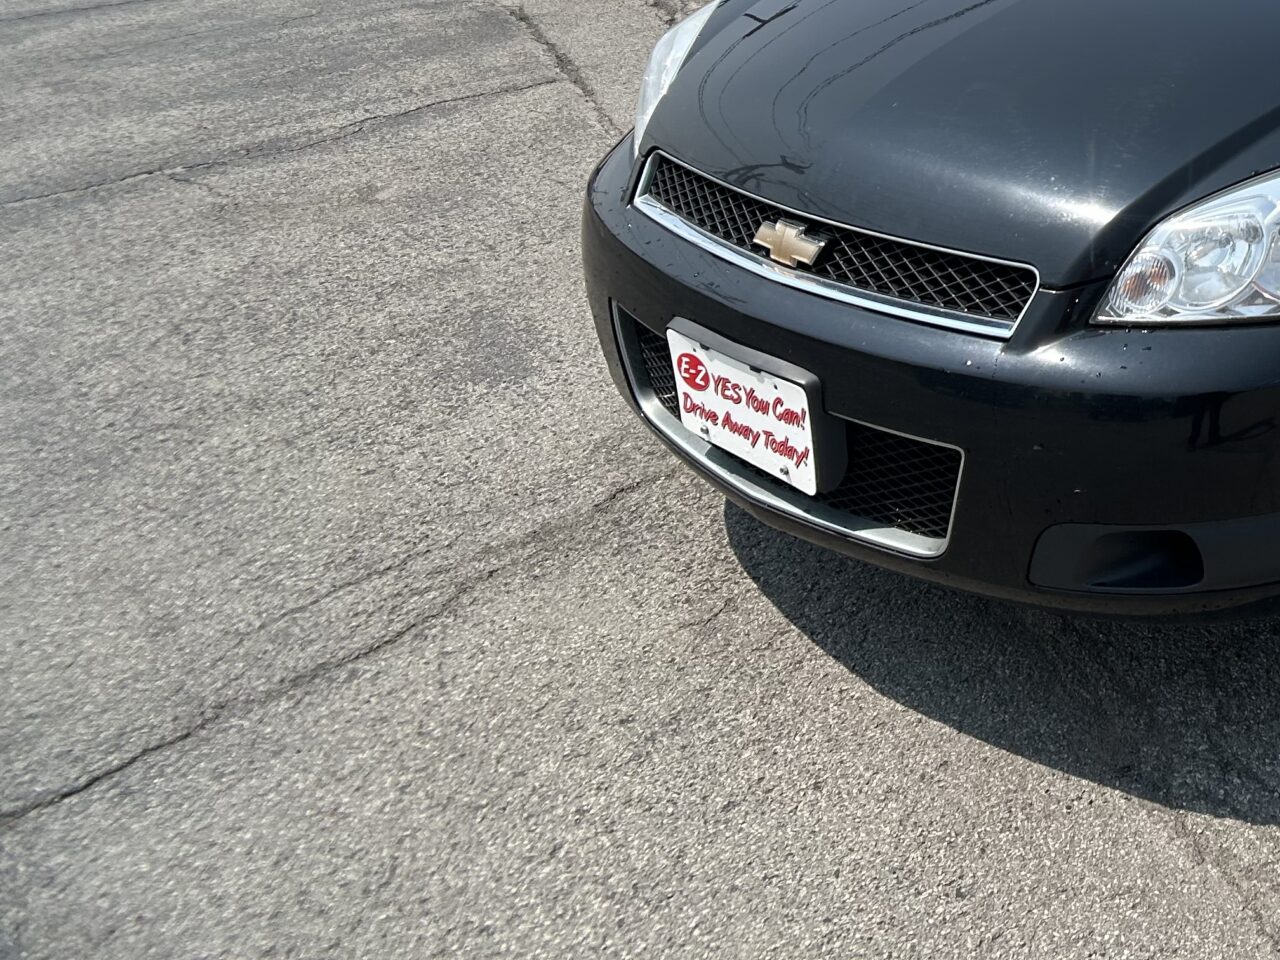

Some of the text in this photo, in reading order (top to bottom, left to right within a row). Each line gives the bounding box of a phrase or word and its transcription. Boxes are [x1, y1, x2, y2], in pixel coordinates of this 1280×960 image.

[679, 356, 806, 430] E-Z YES You Can!
[682, 391, 810, 469] Drive Away Today!
